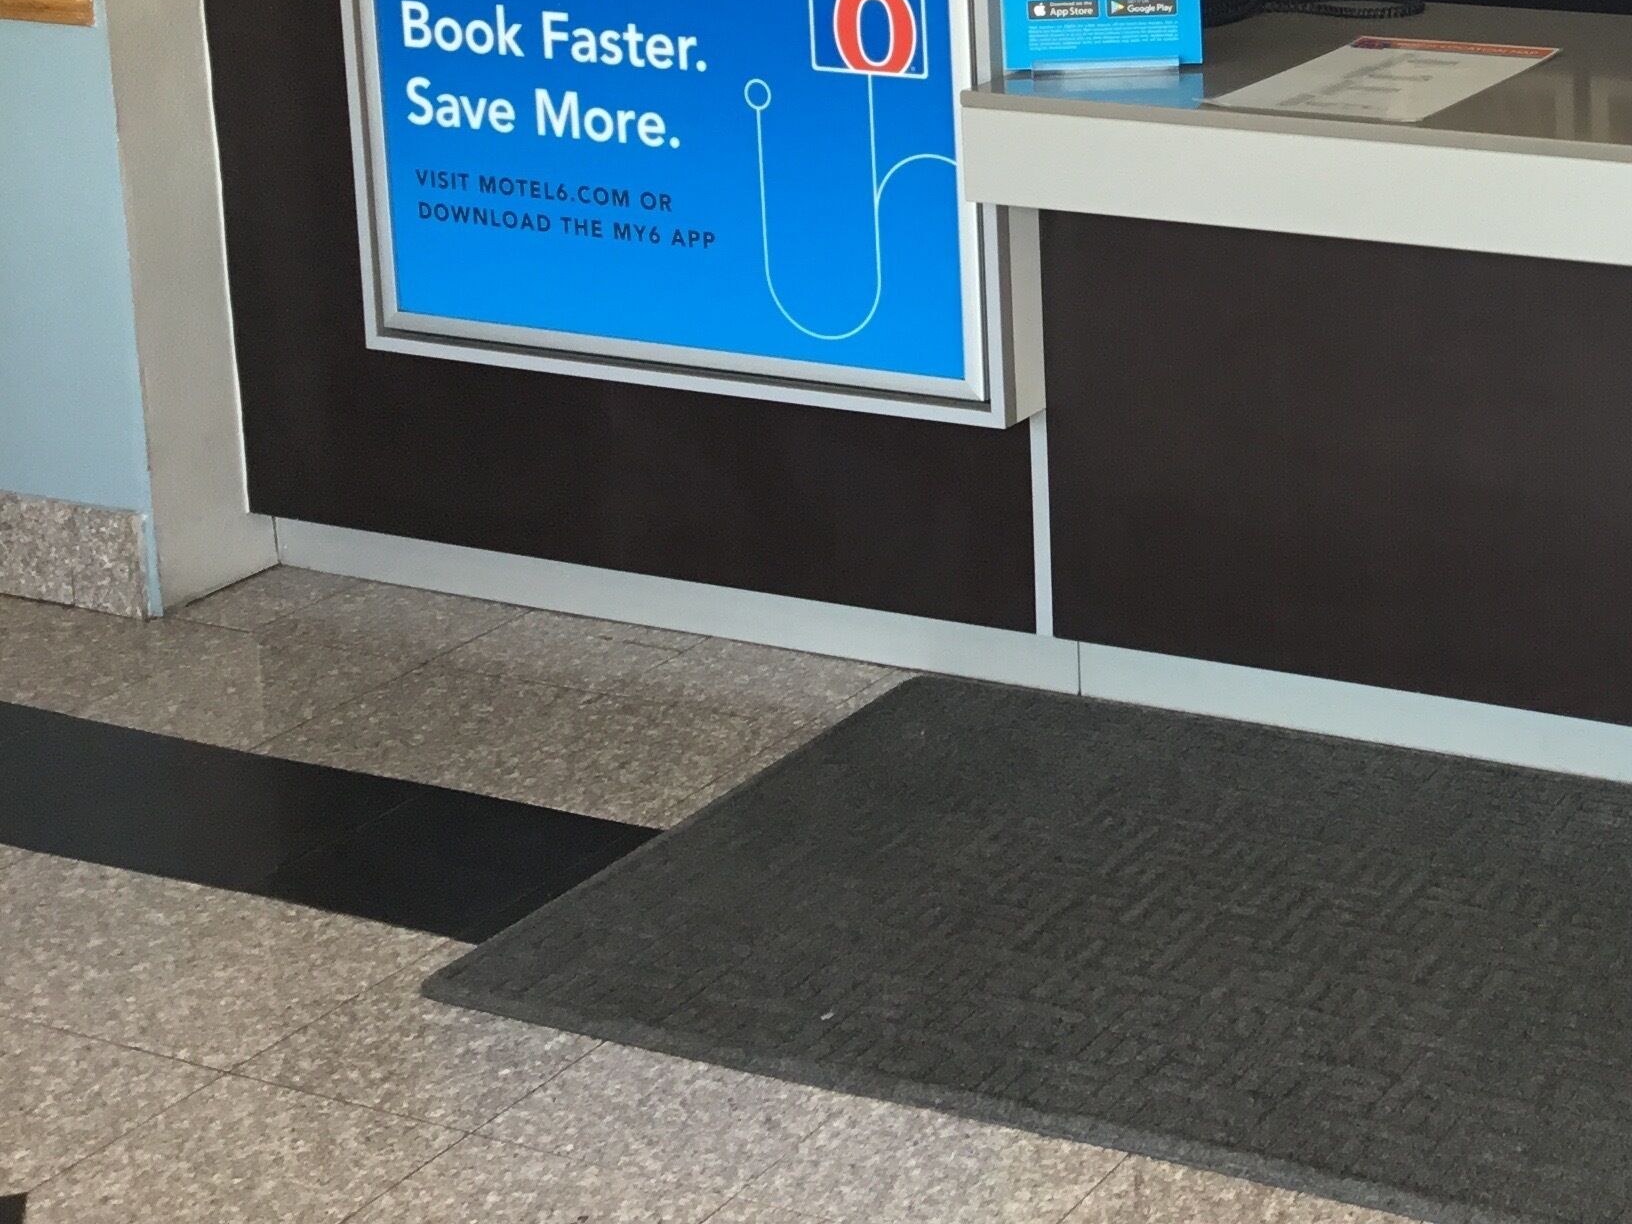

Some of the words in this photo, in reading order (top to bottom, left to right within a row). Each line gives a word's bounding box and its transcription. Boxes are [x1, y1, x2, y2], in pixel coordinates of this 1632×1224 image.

[1050, 7, 1069, 17] App
[1070, 7, 1094, 15] Store
[1127, 4, 1156, 14] Google
[1156, 3, 1174, 14] Play
[401, 0, 524, 58] Book
[541, 11, 708, 73] Faster.
[406, 76, 516, 133] Save
[535, 87, 681, 149] More.
[415, 169, 470, 193] VISIT
[479, 174, 630, 208] MOTEL6.COM
[640, 191, 673, 213] OR
[418, 201, 552, 233] DOWNLOAD
[560, 216, 603, 239] THE
[613, 223, 661, 245] MY6
[671, 229, 716, 249] APP
